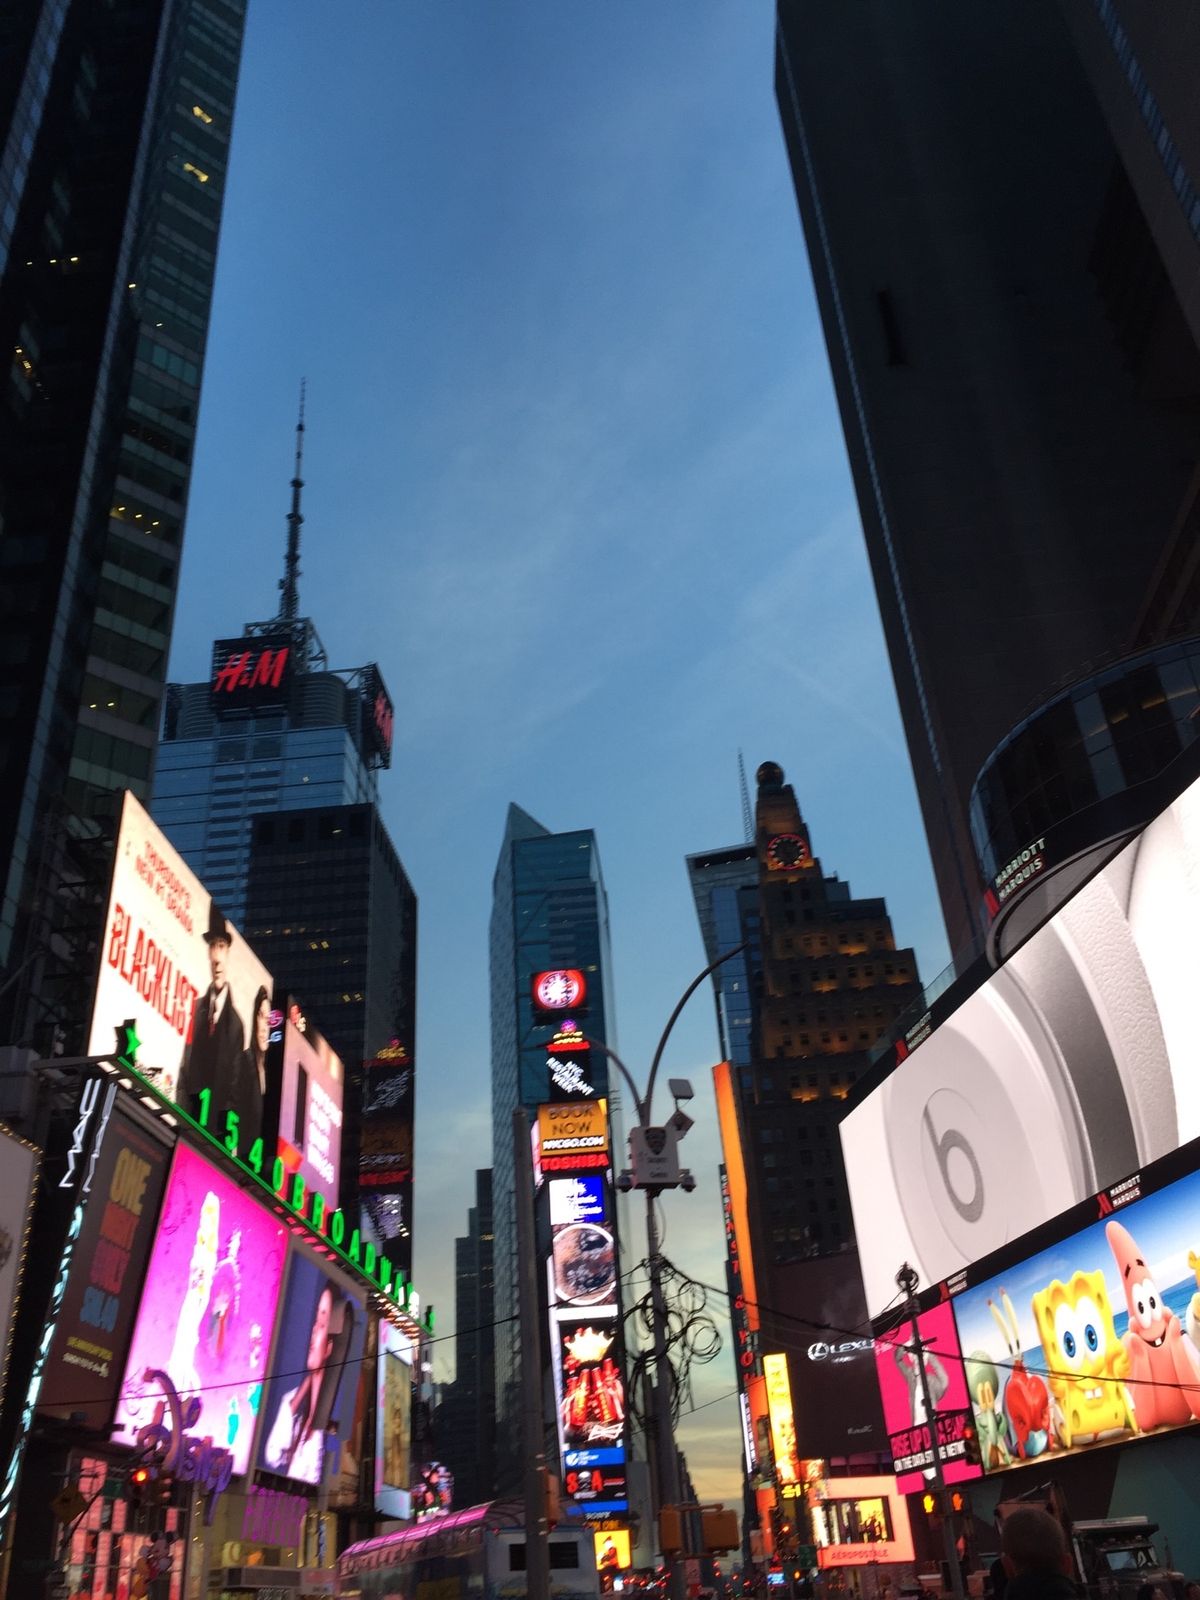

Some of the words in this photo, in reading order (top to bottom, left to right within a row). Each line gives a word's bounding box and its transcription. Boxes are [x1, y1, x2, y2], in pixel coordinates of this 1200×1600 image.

[213, 647, 289, 692] H&M
[995, 837, 1045, 888] MARRIOTT
[999, 857, 1042, 902] MARQUIS
[108, 903, 198, 1045] BLACKLIST
[545, 1057, 595, 1096] RESTAURANT
[552, 1072, 577, 1093] WEEK
[548, 1104, 594, 1119] BOOK
[552, 1120, 592, 1136] NOW
[540, 1153, 609, 1171] TOSHIBA
[199, 1087, 285, 1192] 1540
[292, 1173, 415, 1315] BROADWAY
[1110, 1175, 1140, 1197] MARRIOTT
[1112, 1187, 1140, 1207] MARQUIS
